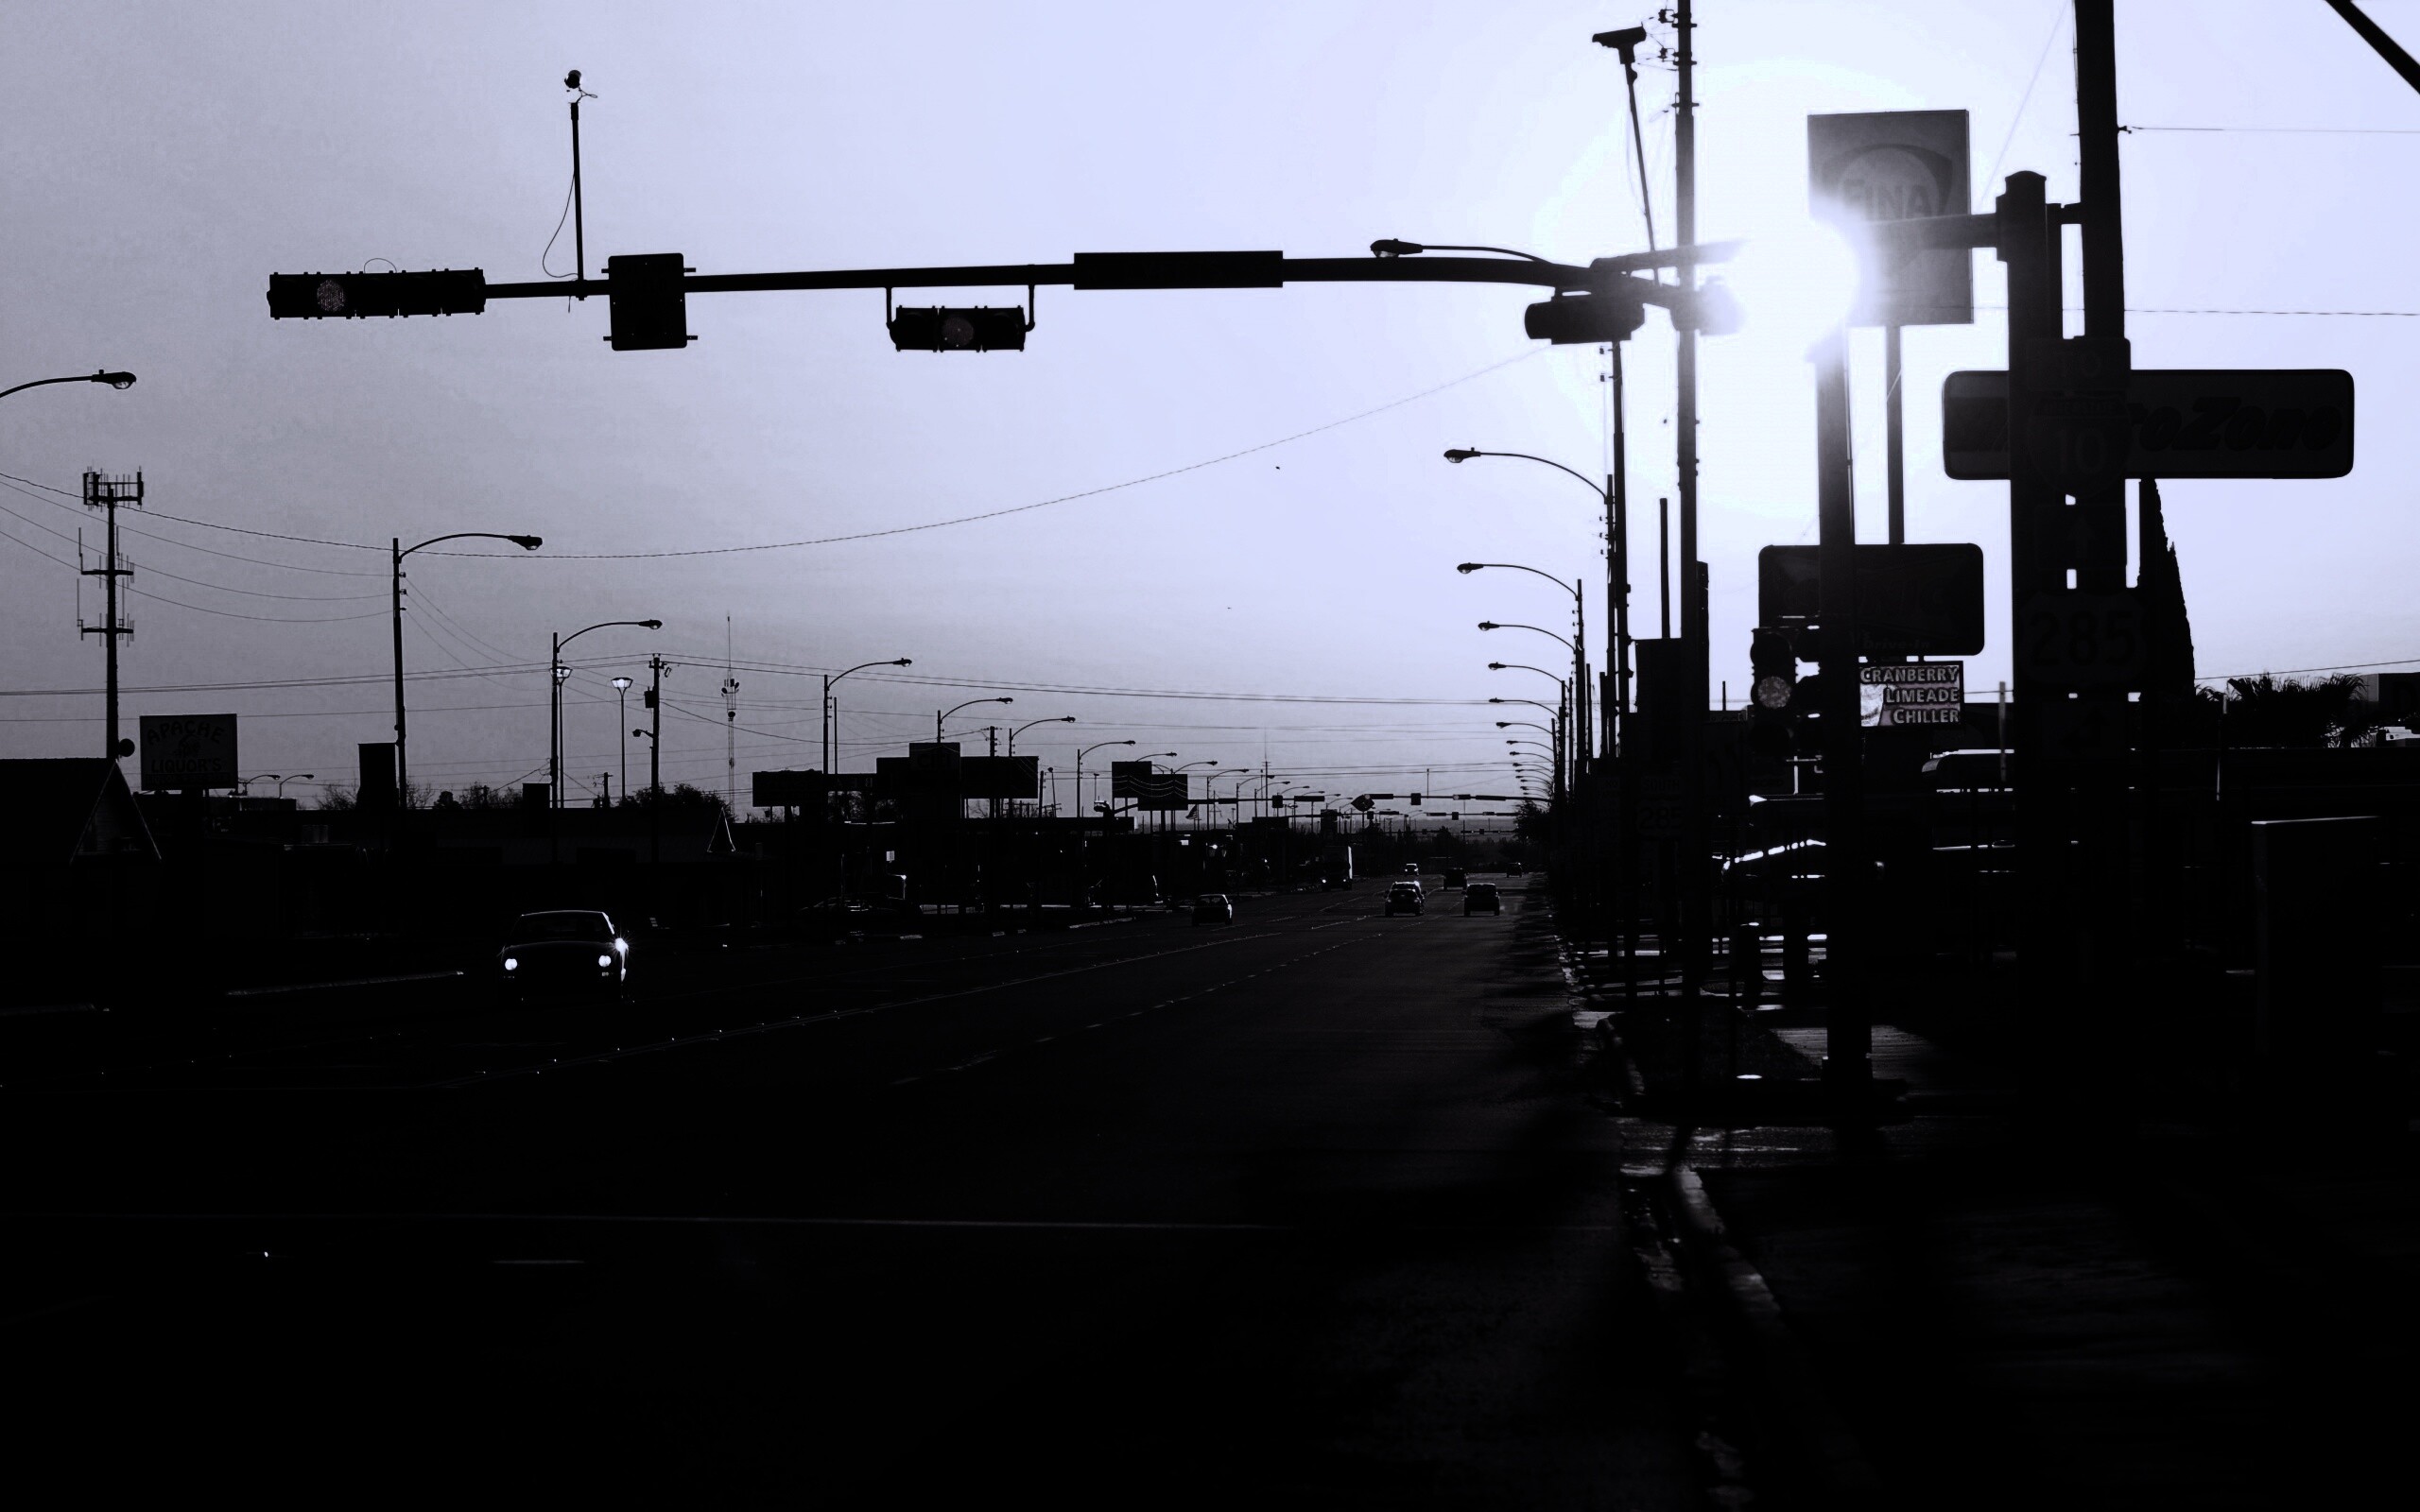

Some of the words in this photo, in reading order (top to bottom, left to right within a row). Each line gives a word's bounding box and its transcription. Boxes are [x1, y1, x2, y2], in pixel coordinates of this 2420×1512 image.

[1841, 178, 1932, 219] FINA
[2054, 427, 2107, 474] 10
[2029, 610, 2136, 666] 285
[1859, 666, 1959, 682] CRANBERRY
[1886, 688, 1959, 703] LIMEADE
[1893, 708, 1959, 724] CHILLER
[147, 719, 226, 746] APACHE
[151, 757, 222, 773] LIQUOR'S
